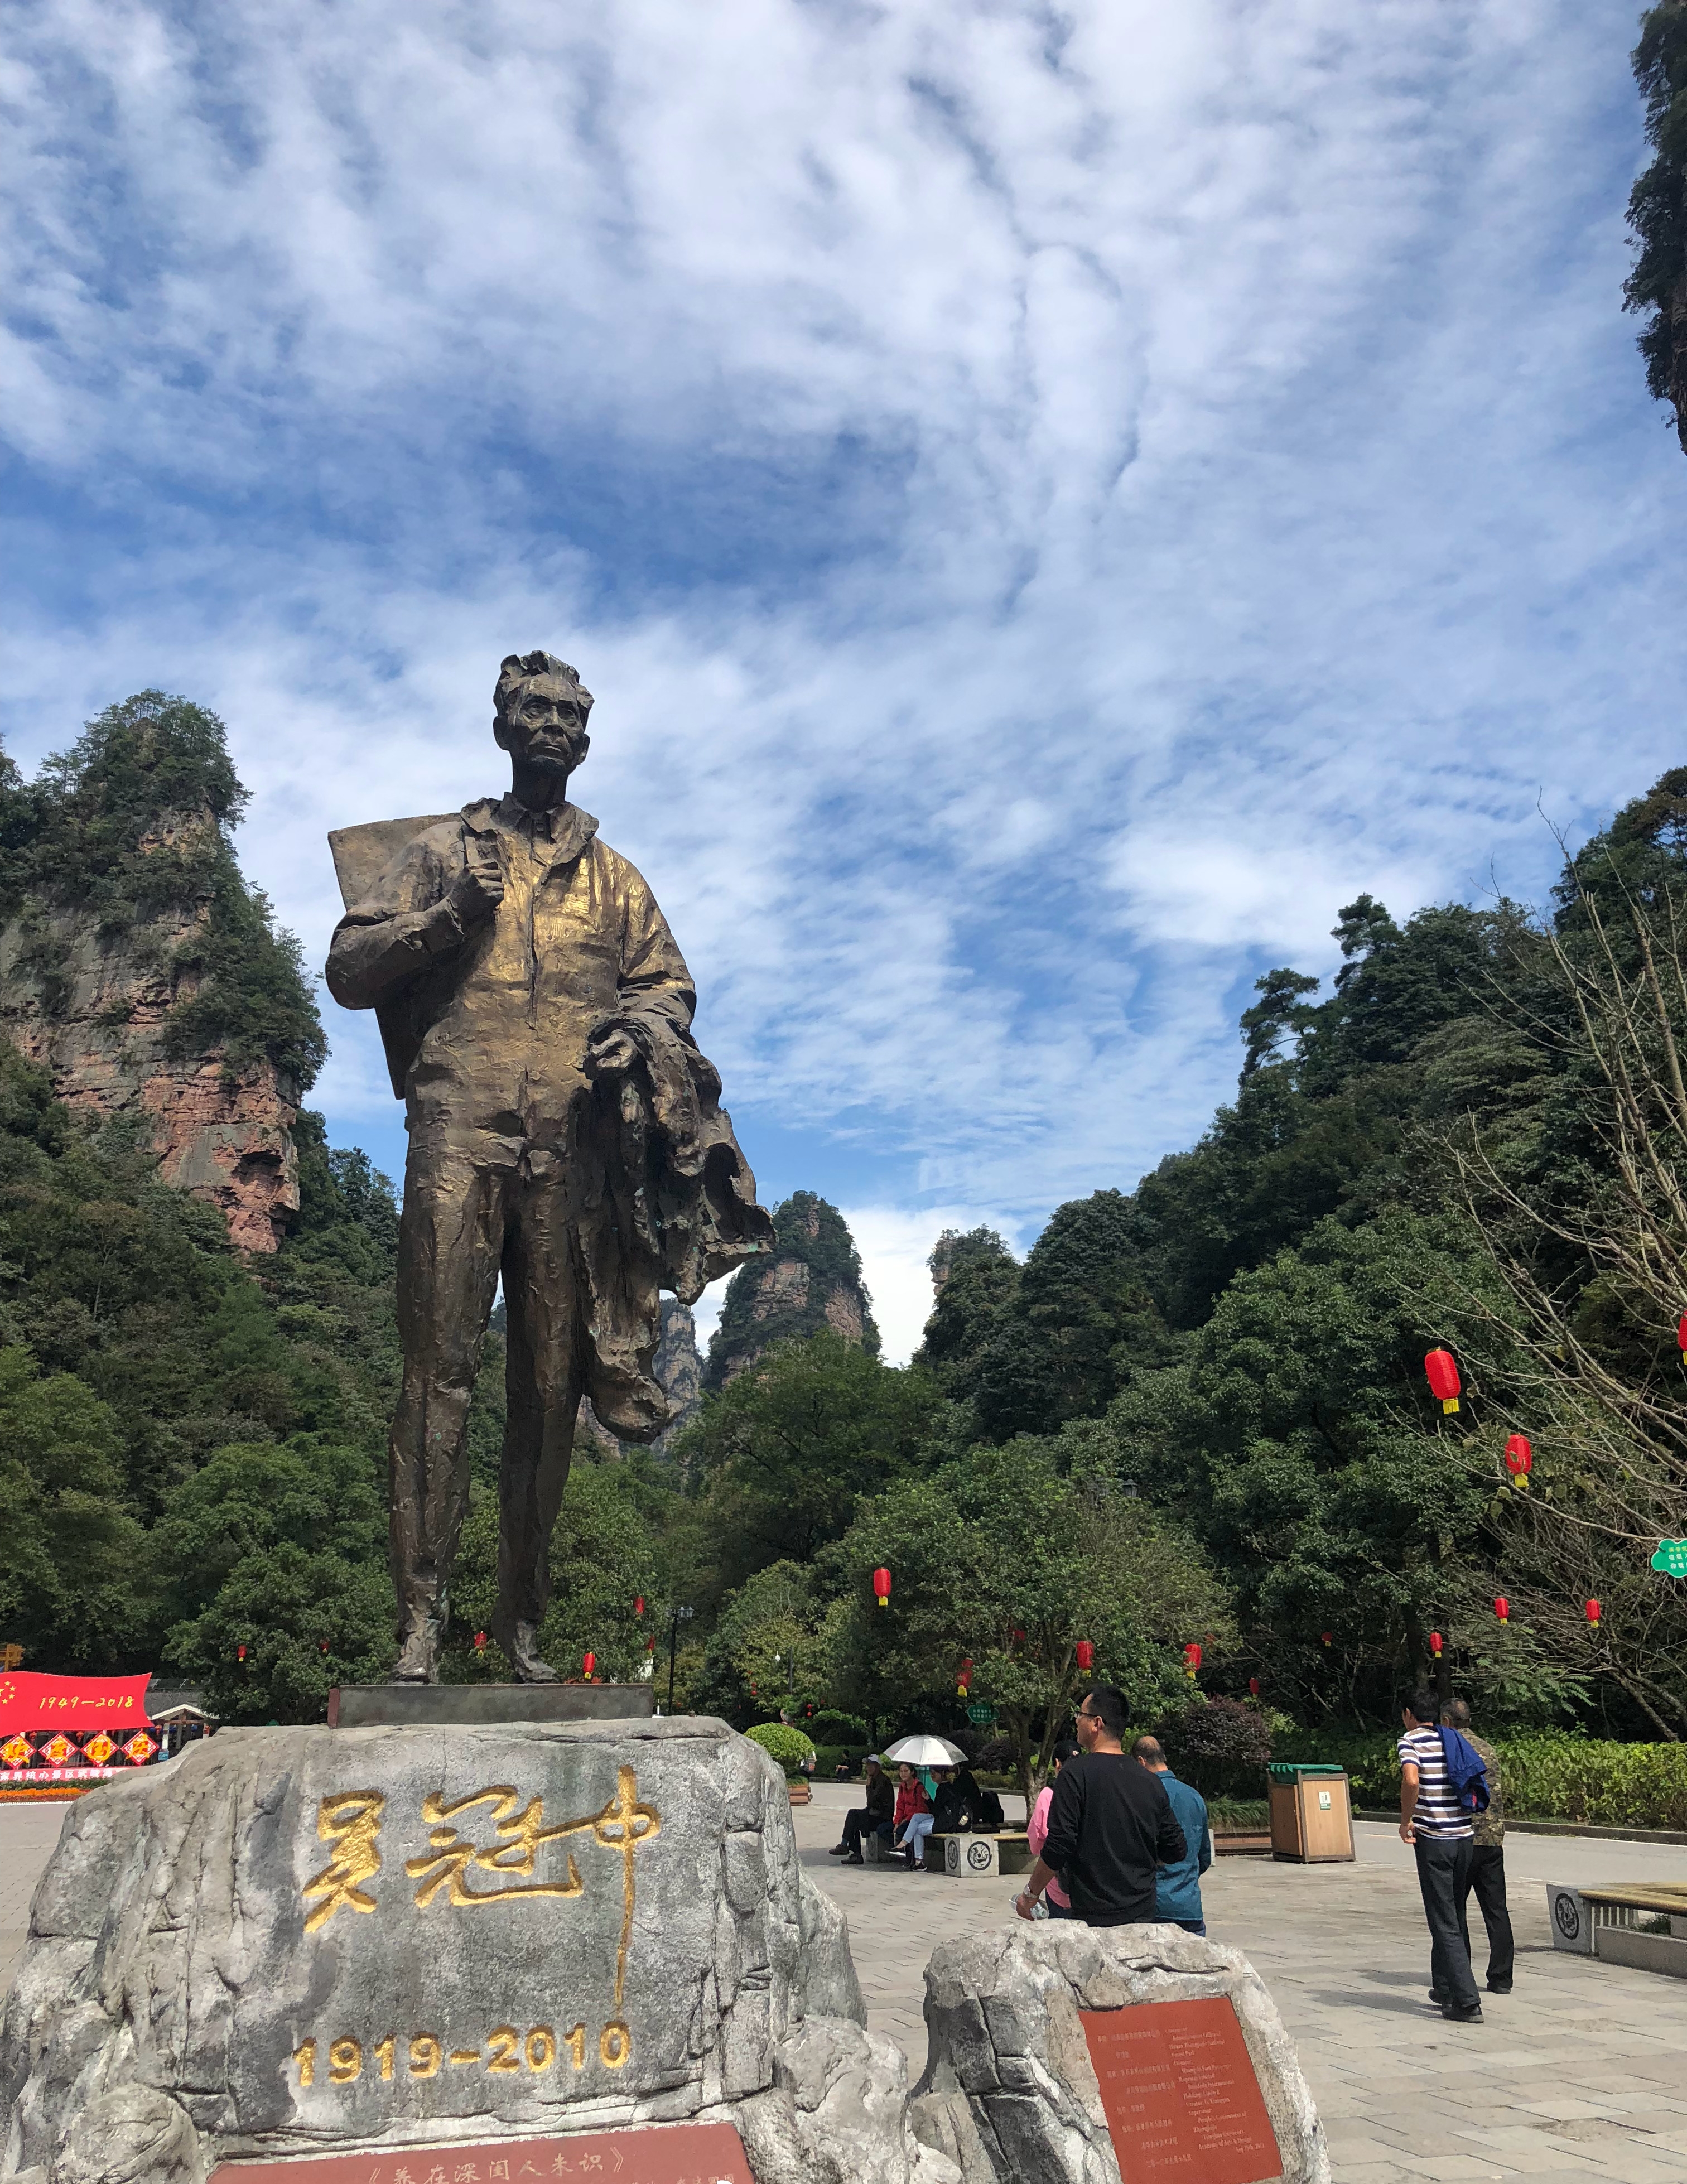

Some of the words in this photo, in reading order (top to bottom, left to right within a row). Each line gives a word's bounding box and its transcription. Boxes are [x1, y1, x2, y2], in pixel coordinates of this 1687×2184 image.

[0, 1733, 150, 1764] 欢度国庆
[0, 1768, 123, 1781] 家界核心景区武陵源
[301, 1764, 661, 2019] 吴冠中
[292, 2021, 632, 2087] 1919-2010
